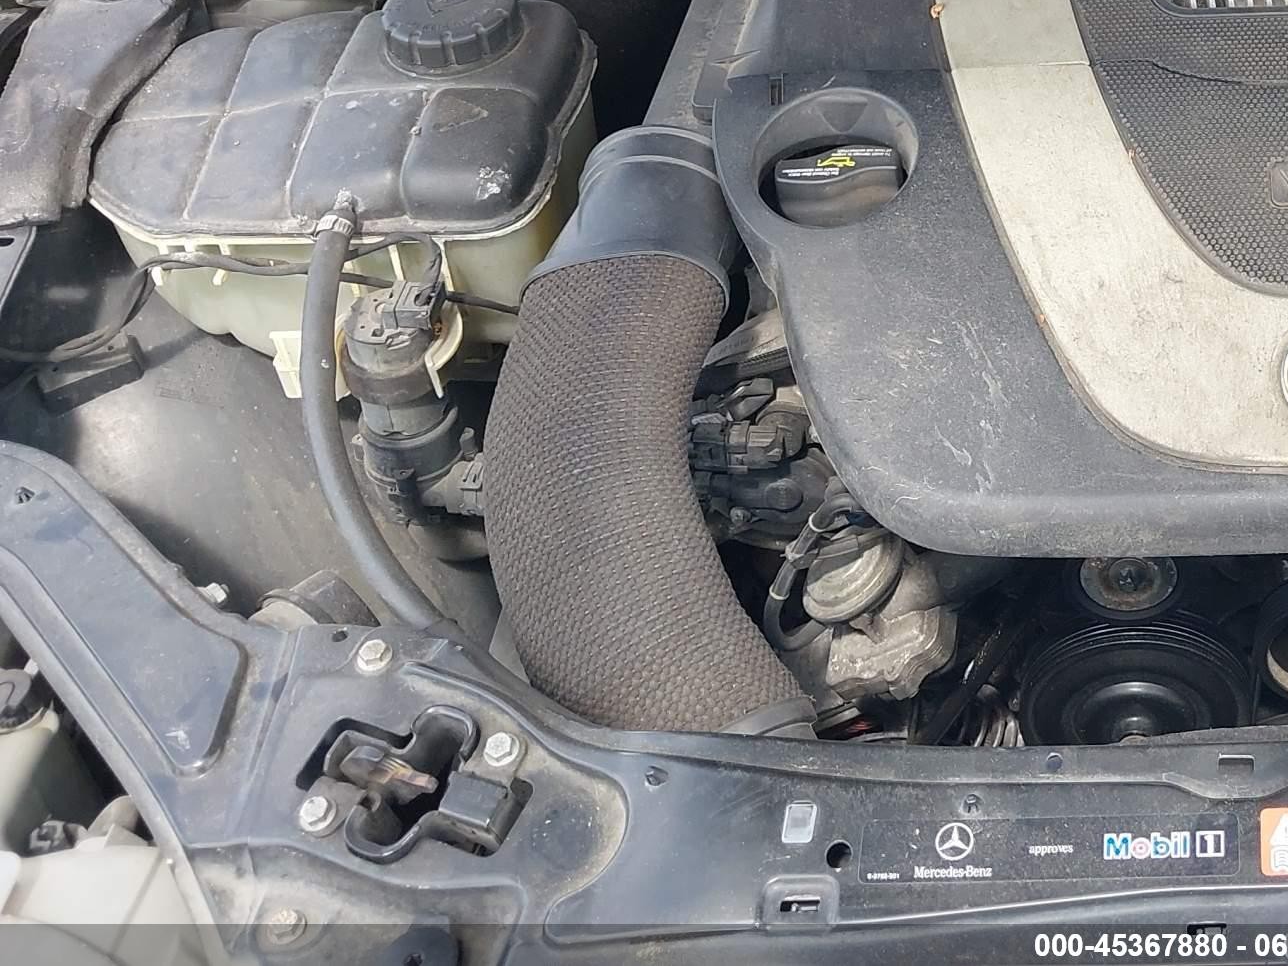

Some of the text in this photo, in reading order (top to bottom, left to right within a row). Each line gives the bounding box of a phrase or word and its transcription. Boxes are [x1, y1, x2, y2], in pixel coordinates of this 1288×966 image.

[1029, 844, 1074, 856] approves
[1104, 832, 1190, 860] Mobil
[914, 865, 993, 879] Mercedes-Benz
